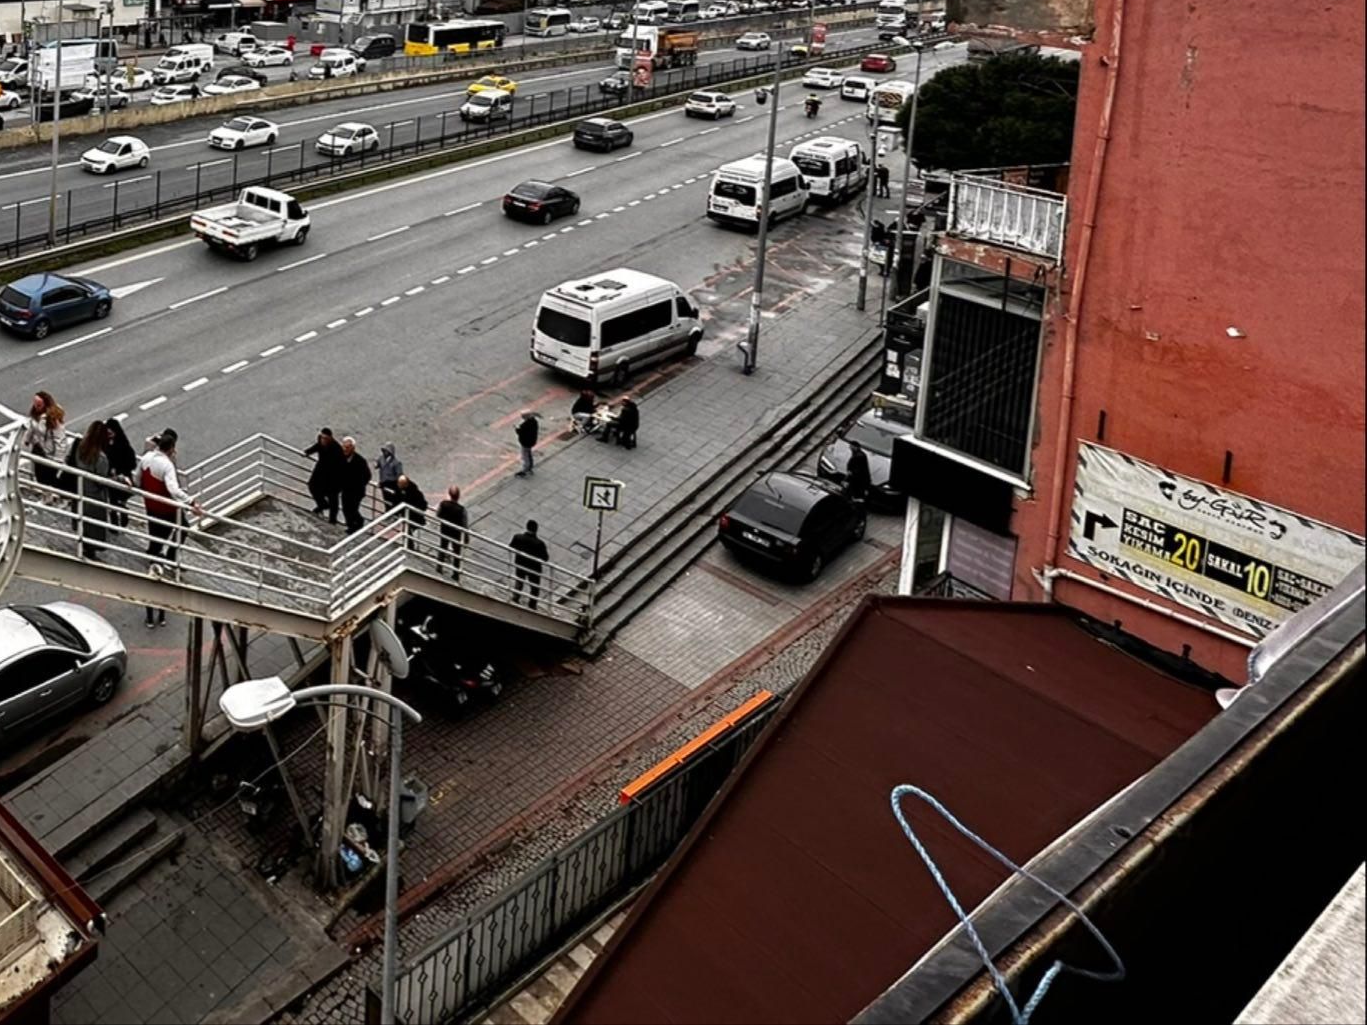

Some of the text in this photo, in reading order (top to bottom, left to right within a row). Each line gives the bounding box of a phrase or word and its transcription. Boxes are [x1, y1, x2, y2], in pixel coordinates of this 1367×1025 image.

[1171, 531, 1200, 571] 20
[1207, 553, 1243, 578] SAKAL
[1087, 545, 1162, 583] SOKAĞIN
[1166, 576, 1226, 612] İÇİNDE
[1244, 561, 1270, 598] 10
